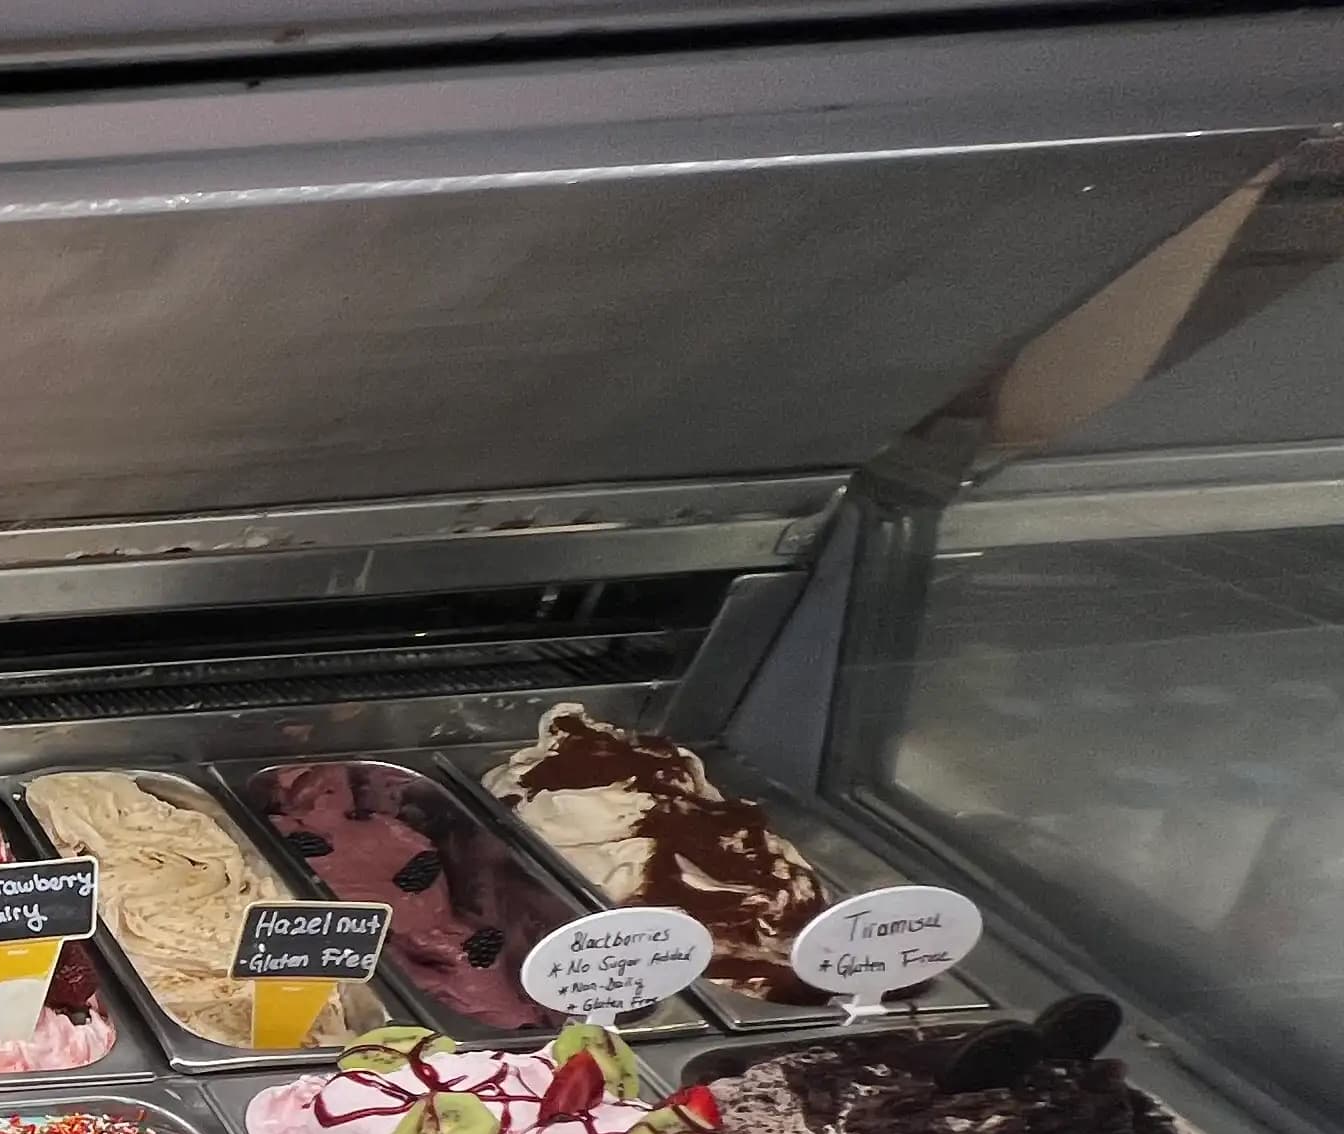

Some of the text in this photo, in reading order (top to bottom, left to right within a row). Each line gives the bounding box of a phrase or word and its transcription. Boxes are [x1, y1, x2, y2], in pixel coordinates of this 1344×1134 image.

[844, 910, 942, 941] Tiramisu
[321, 948, 376, 970] Free
[567, 959, 591, 975] No
[599, 955, 641, 976] Sugar
[836, 948, 952, 979] Gluten Free
